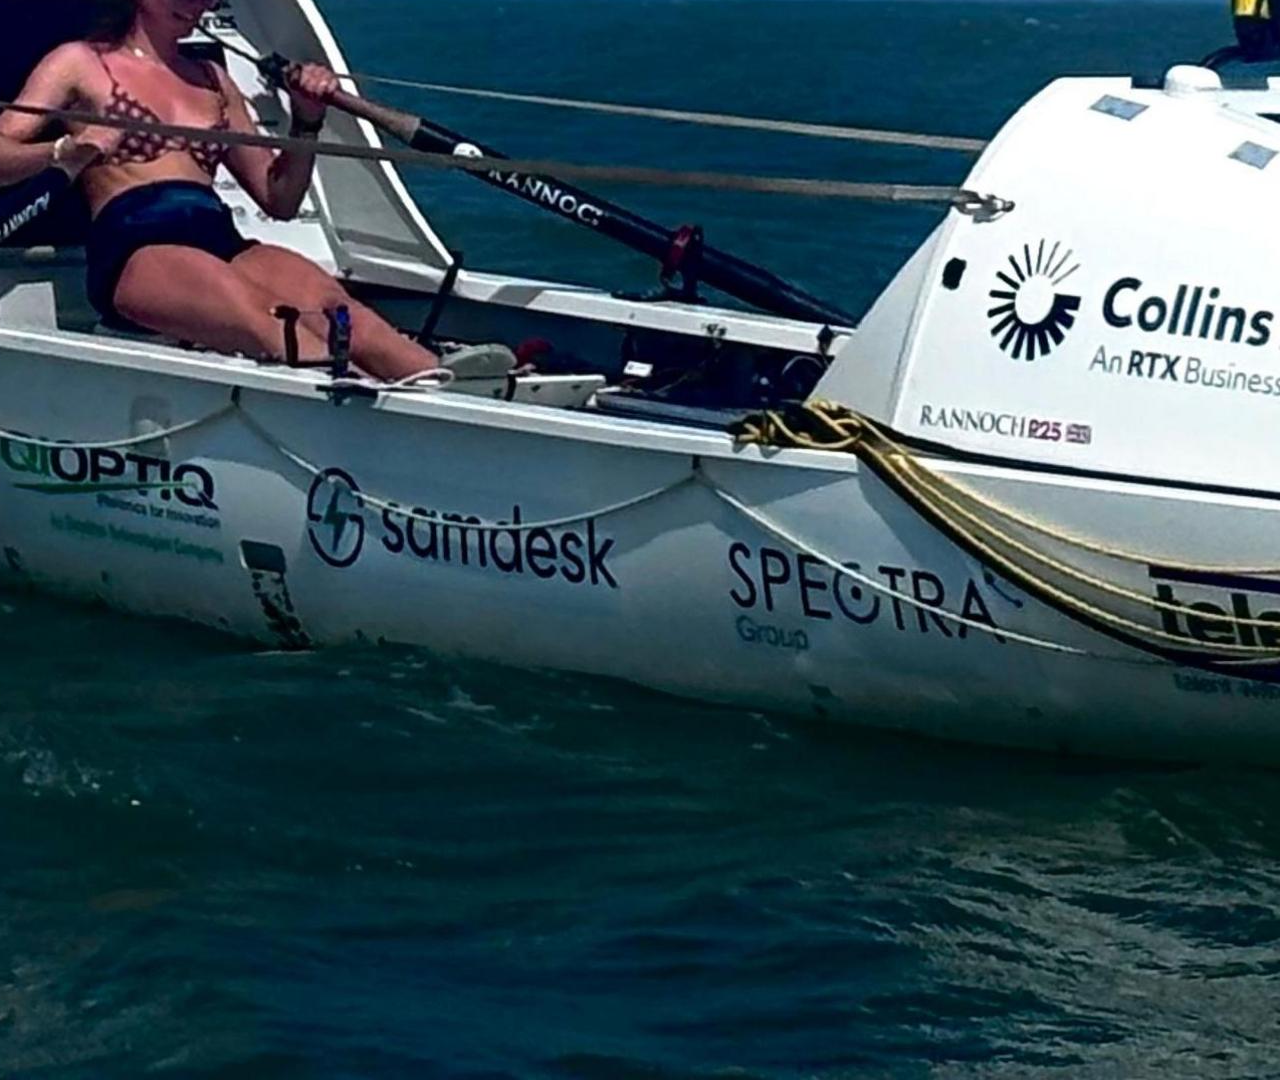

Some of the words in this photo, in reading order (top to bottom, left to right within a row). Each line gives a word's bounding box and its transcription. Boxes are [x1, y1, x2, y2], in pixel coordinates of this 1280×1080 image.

[488, 168, 604, 226] ANNOC
[1101, 275, 1275, 348] Collins
[1089, 344, 1122, 374] An
[1126, 350, 1182, 382] RTX
[919, 404, 1027, 439] RANNOCH
[0, 429, 219, 510] QIOPTIQ
[381, 501, 618, 589] samdesk
[728, 541, 1008, 644] SPECTRA
[735, 614, 810, 651] Group
